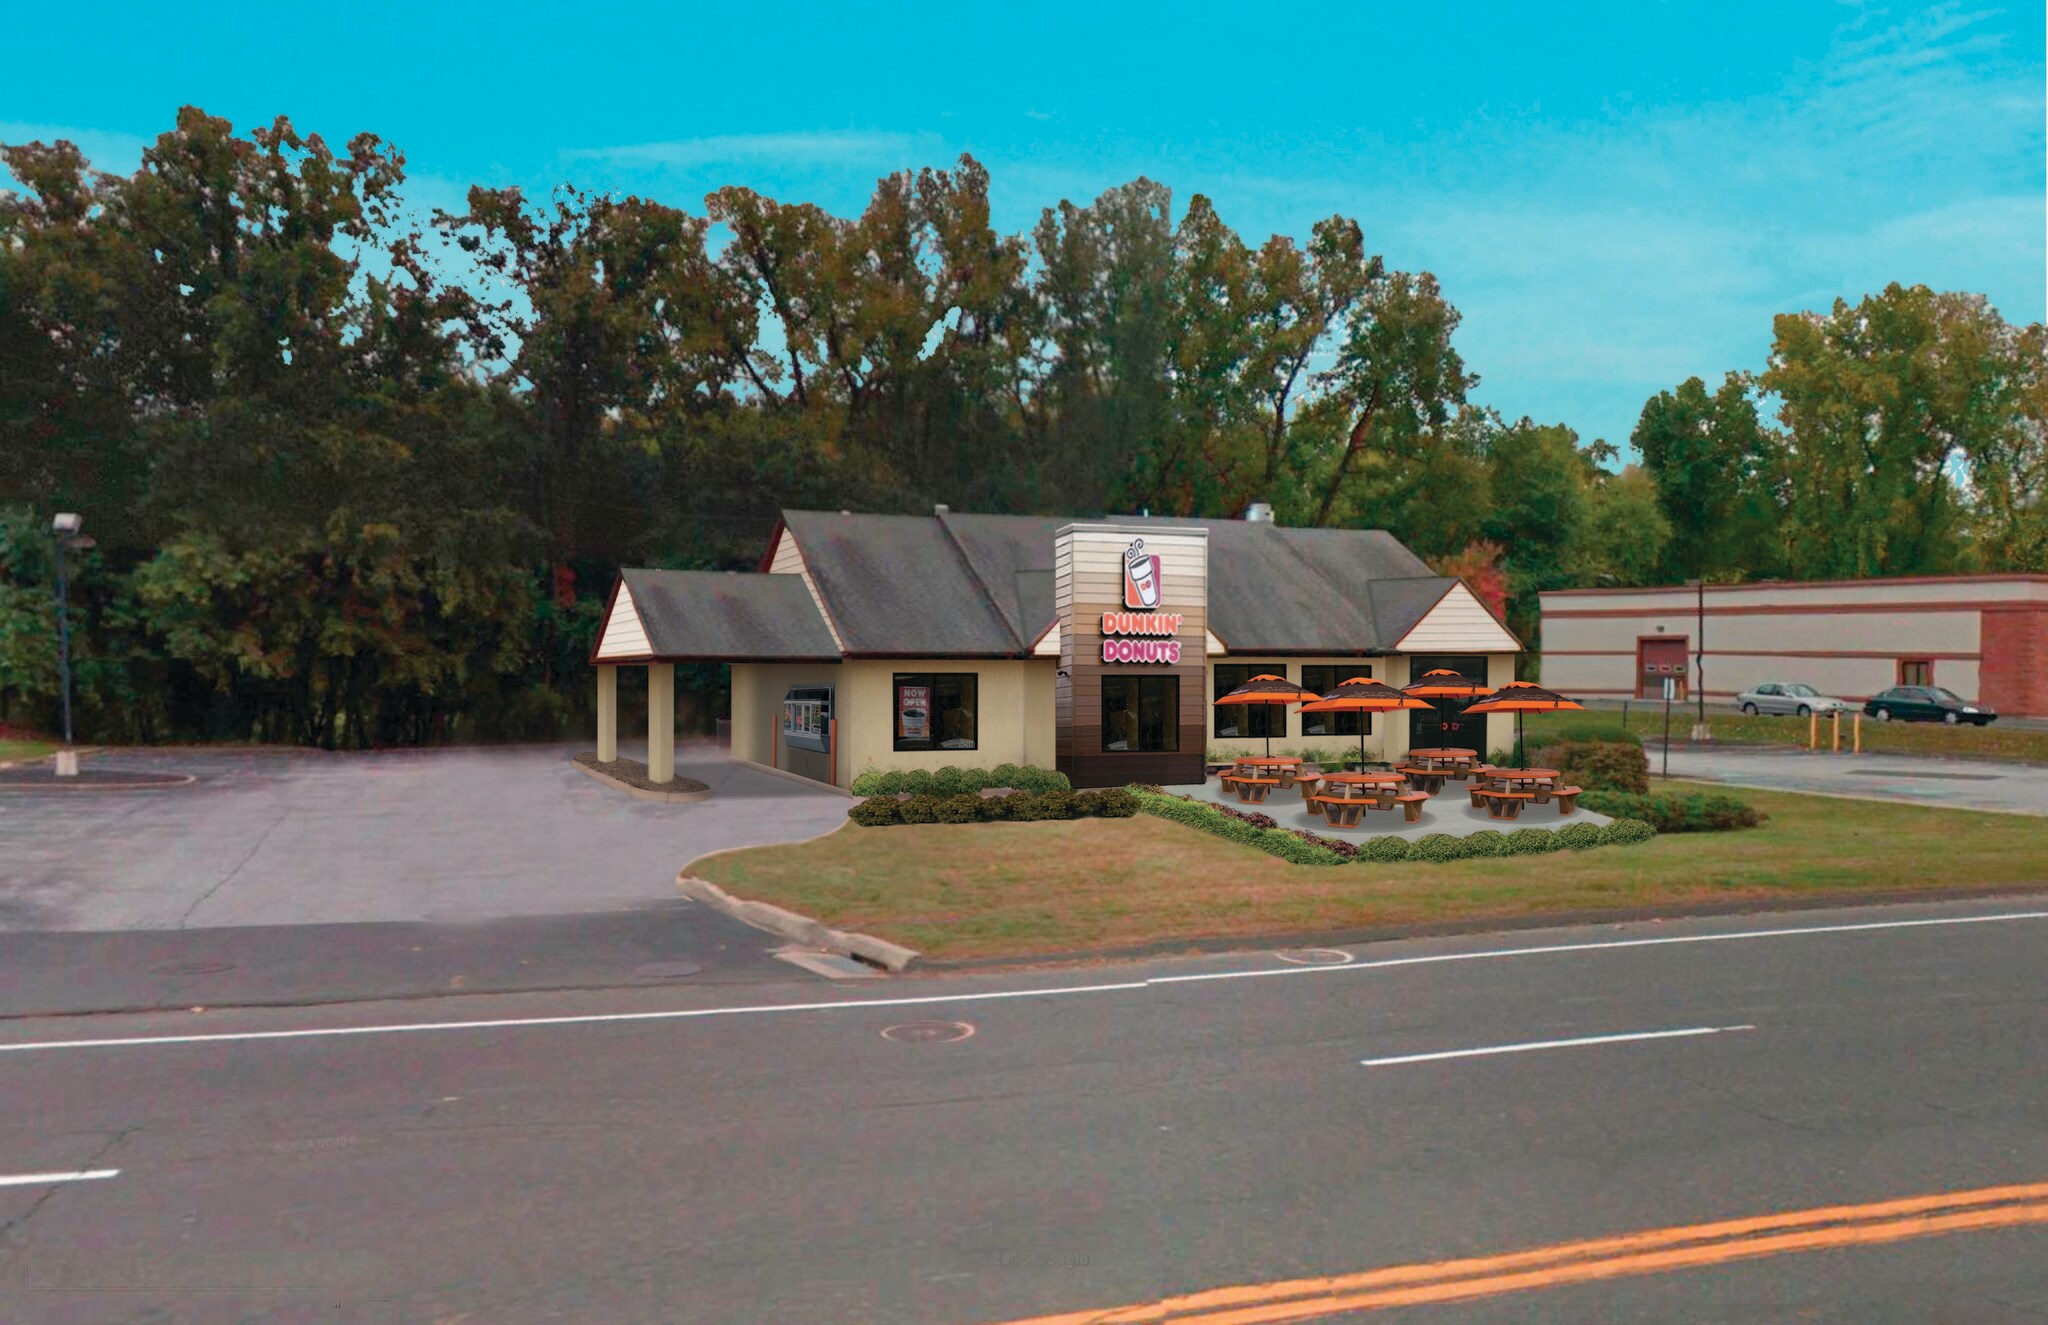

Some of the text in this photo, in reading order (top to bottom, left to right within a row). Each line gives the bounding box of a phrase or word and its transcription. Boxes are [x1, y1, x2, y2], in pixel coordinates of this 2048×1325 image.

[1140, 580, 1152, 591] DD
[1103, 612, 1182, 635] DUNKIN'
[1103, 640, 1181, 663] DONUTS
[904, 689, 926, 697] NOW
[903, 698, 927, 707] OPEN
